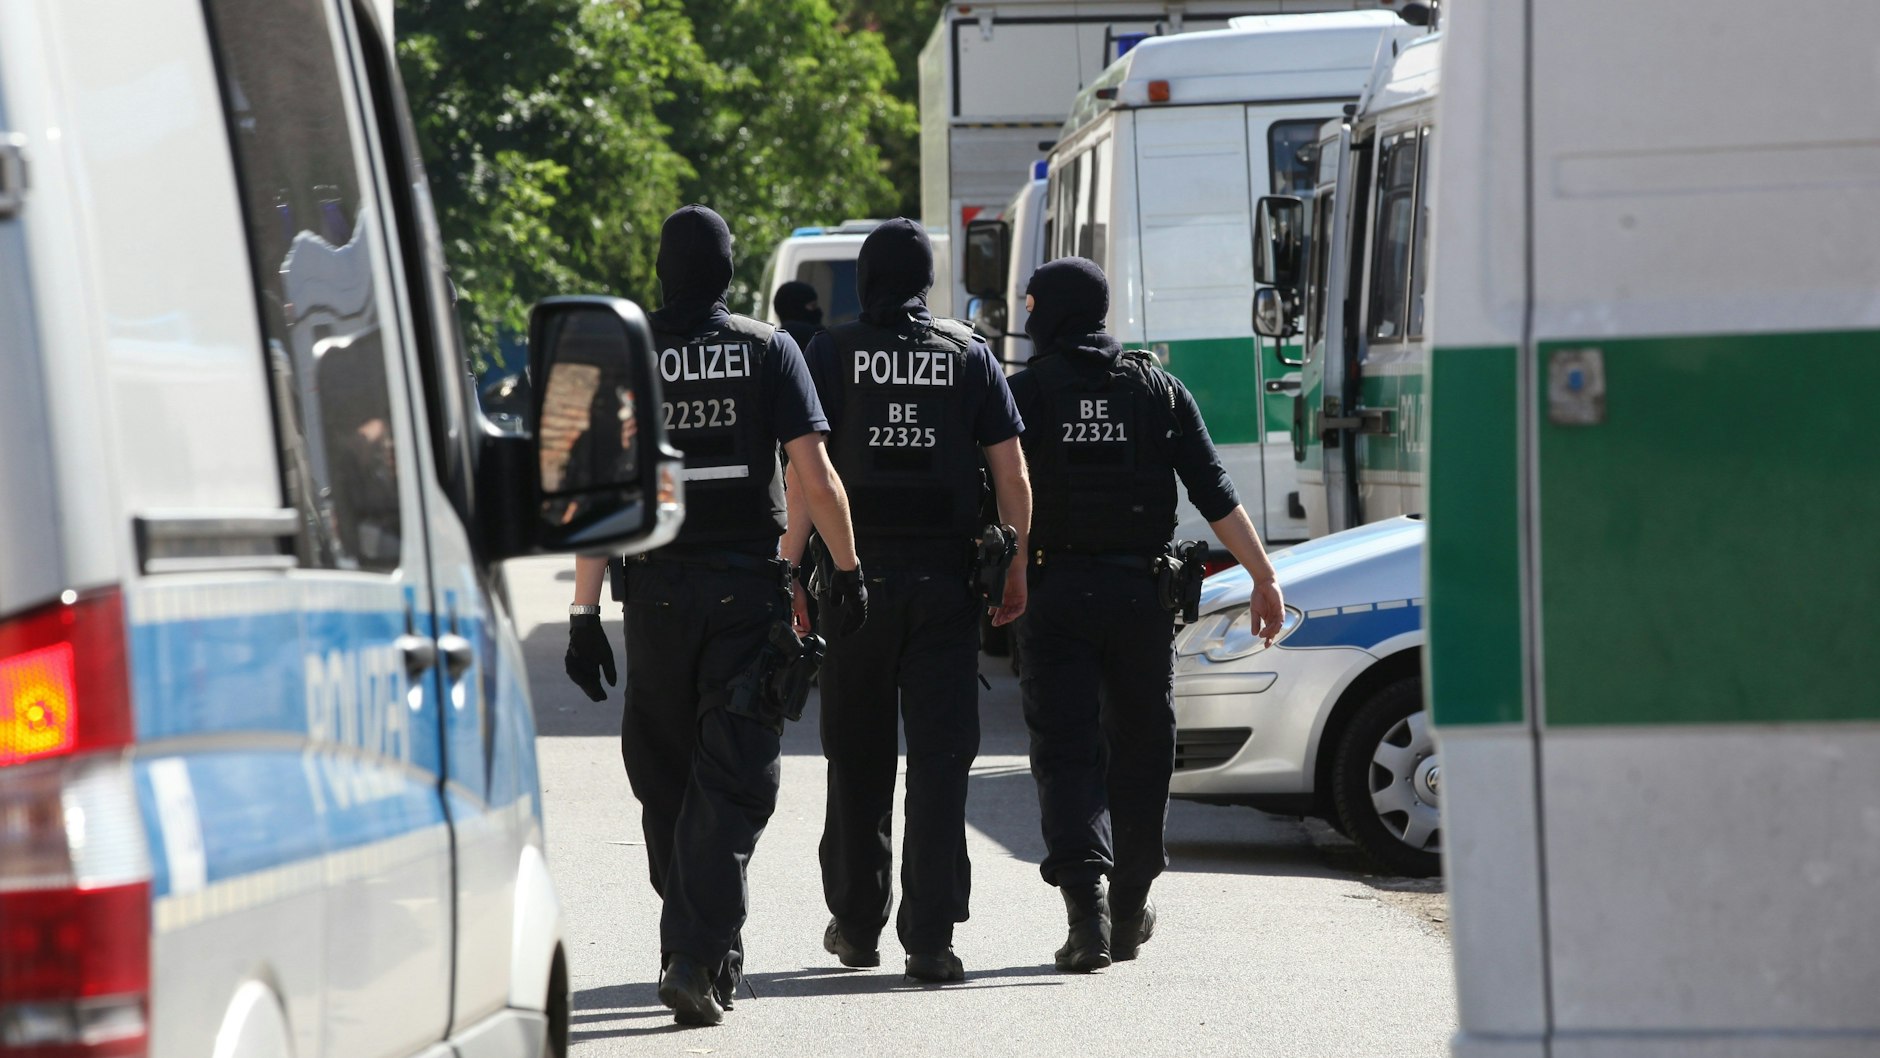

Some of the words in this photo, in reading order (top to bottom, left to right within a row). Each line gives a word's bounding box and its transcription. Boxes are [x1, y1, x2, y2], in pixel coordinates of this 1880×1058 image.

[854, 350, 954, 386] POLIZEI
[661, 398, 737, 430] 22323
[888, 403, 918, 424] BE
[1080, 399, 1109, 420] BE
[868, 426, 936, 447] 22325
[1062, 422, 1128, 442] 22321
